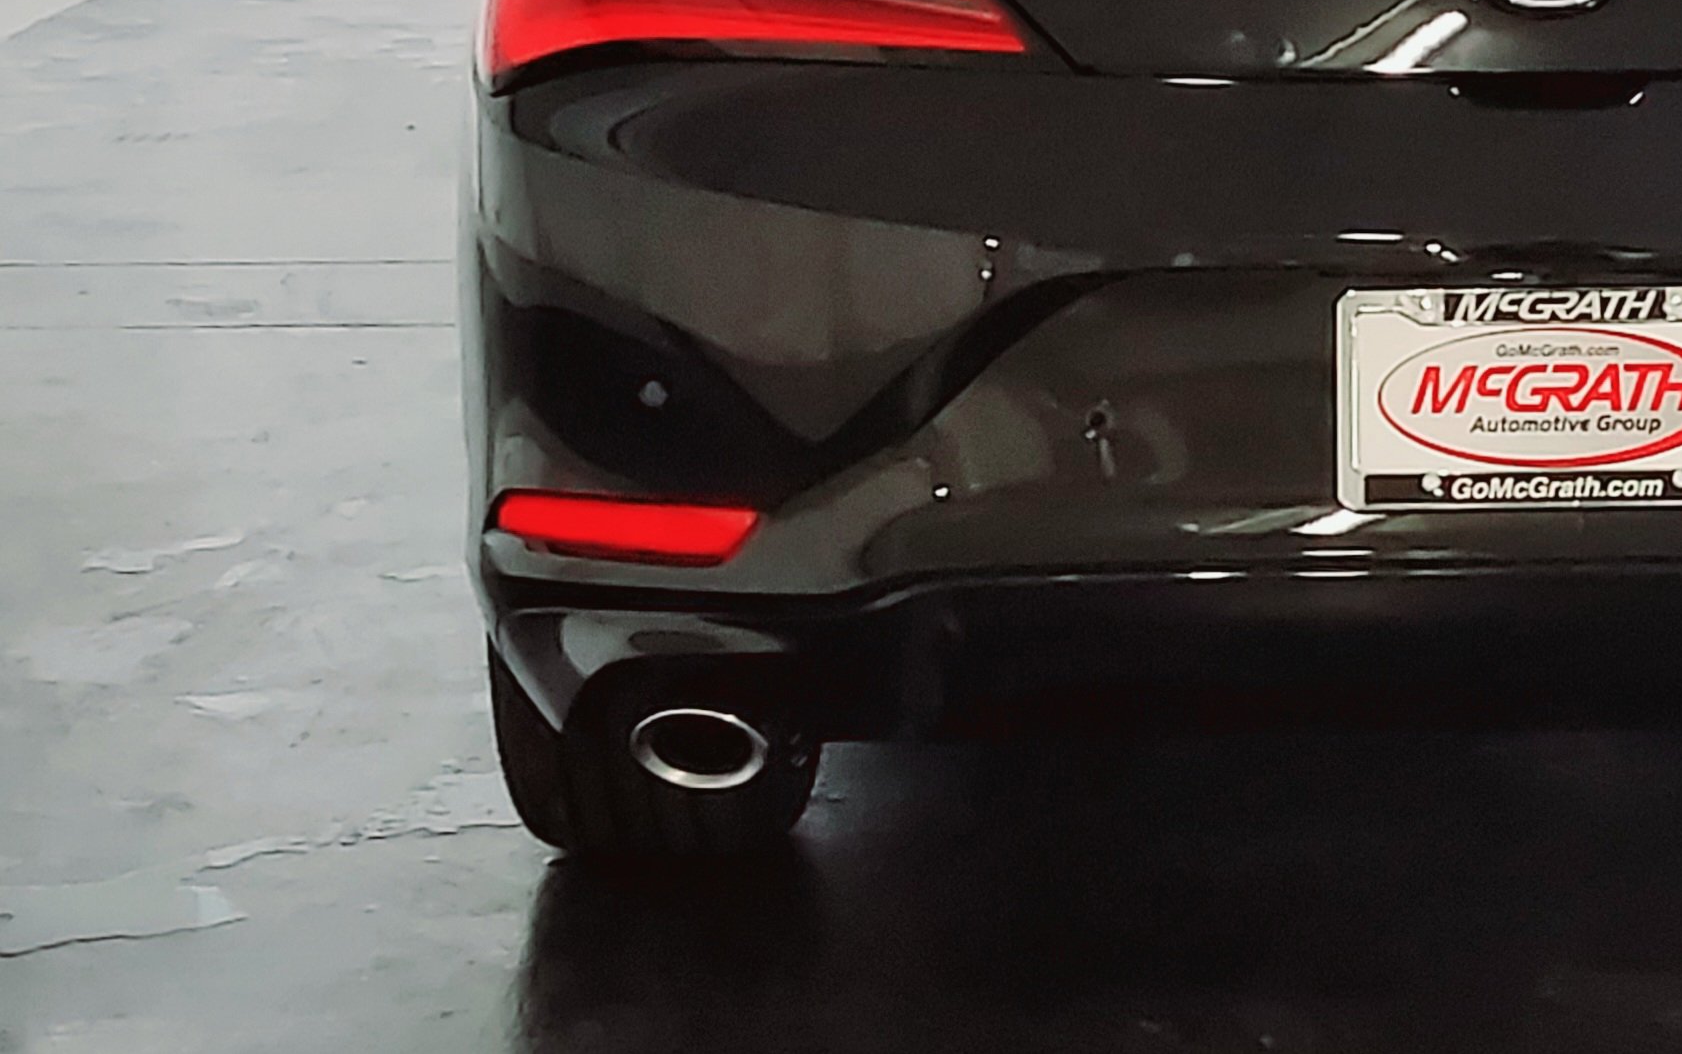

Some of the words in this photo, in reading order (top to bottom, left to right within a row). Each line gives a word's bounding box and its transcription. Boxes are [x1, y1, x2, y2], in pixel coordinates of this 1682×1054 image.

[1496, 344, 1620, 357] GoMcGrath.com
[1470, 415, 1589, 433] Automotive
[1597, 415, 1662, 434] Group
[1451, 476, 1664, 500] GoMcGrath.com
